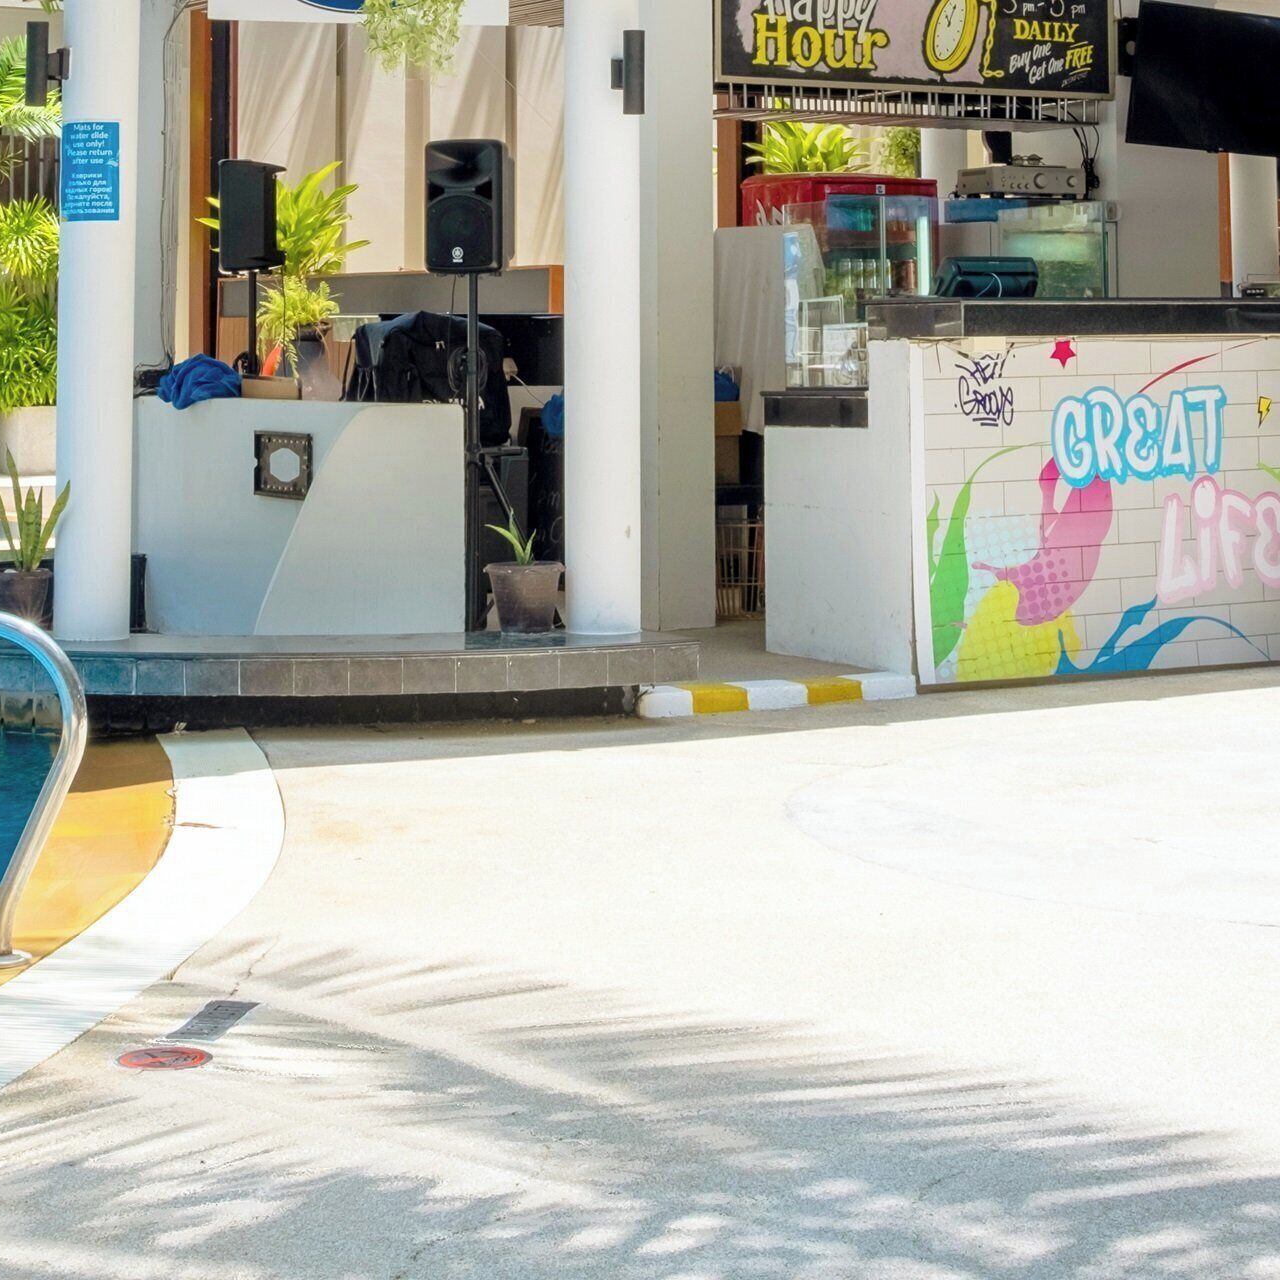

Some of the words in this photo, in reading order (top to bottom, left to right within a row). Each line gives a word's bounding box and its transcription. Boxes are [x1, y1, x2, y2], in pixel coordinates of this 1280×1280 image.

[752, 11, 889, 70] Hour
[1013, 19, 1080, 43] DAILY
[1065, 45, 1095, 70] FREE
[92, 123, 104, 131] for
[1051, 384, 1227, 489] GREAT
